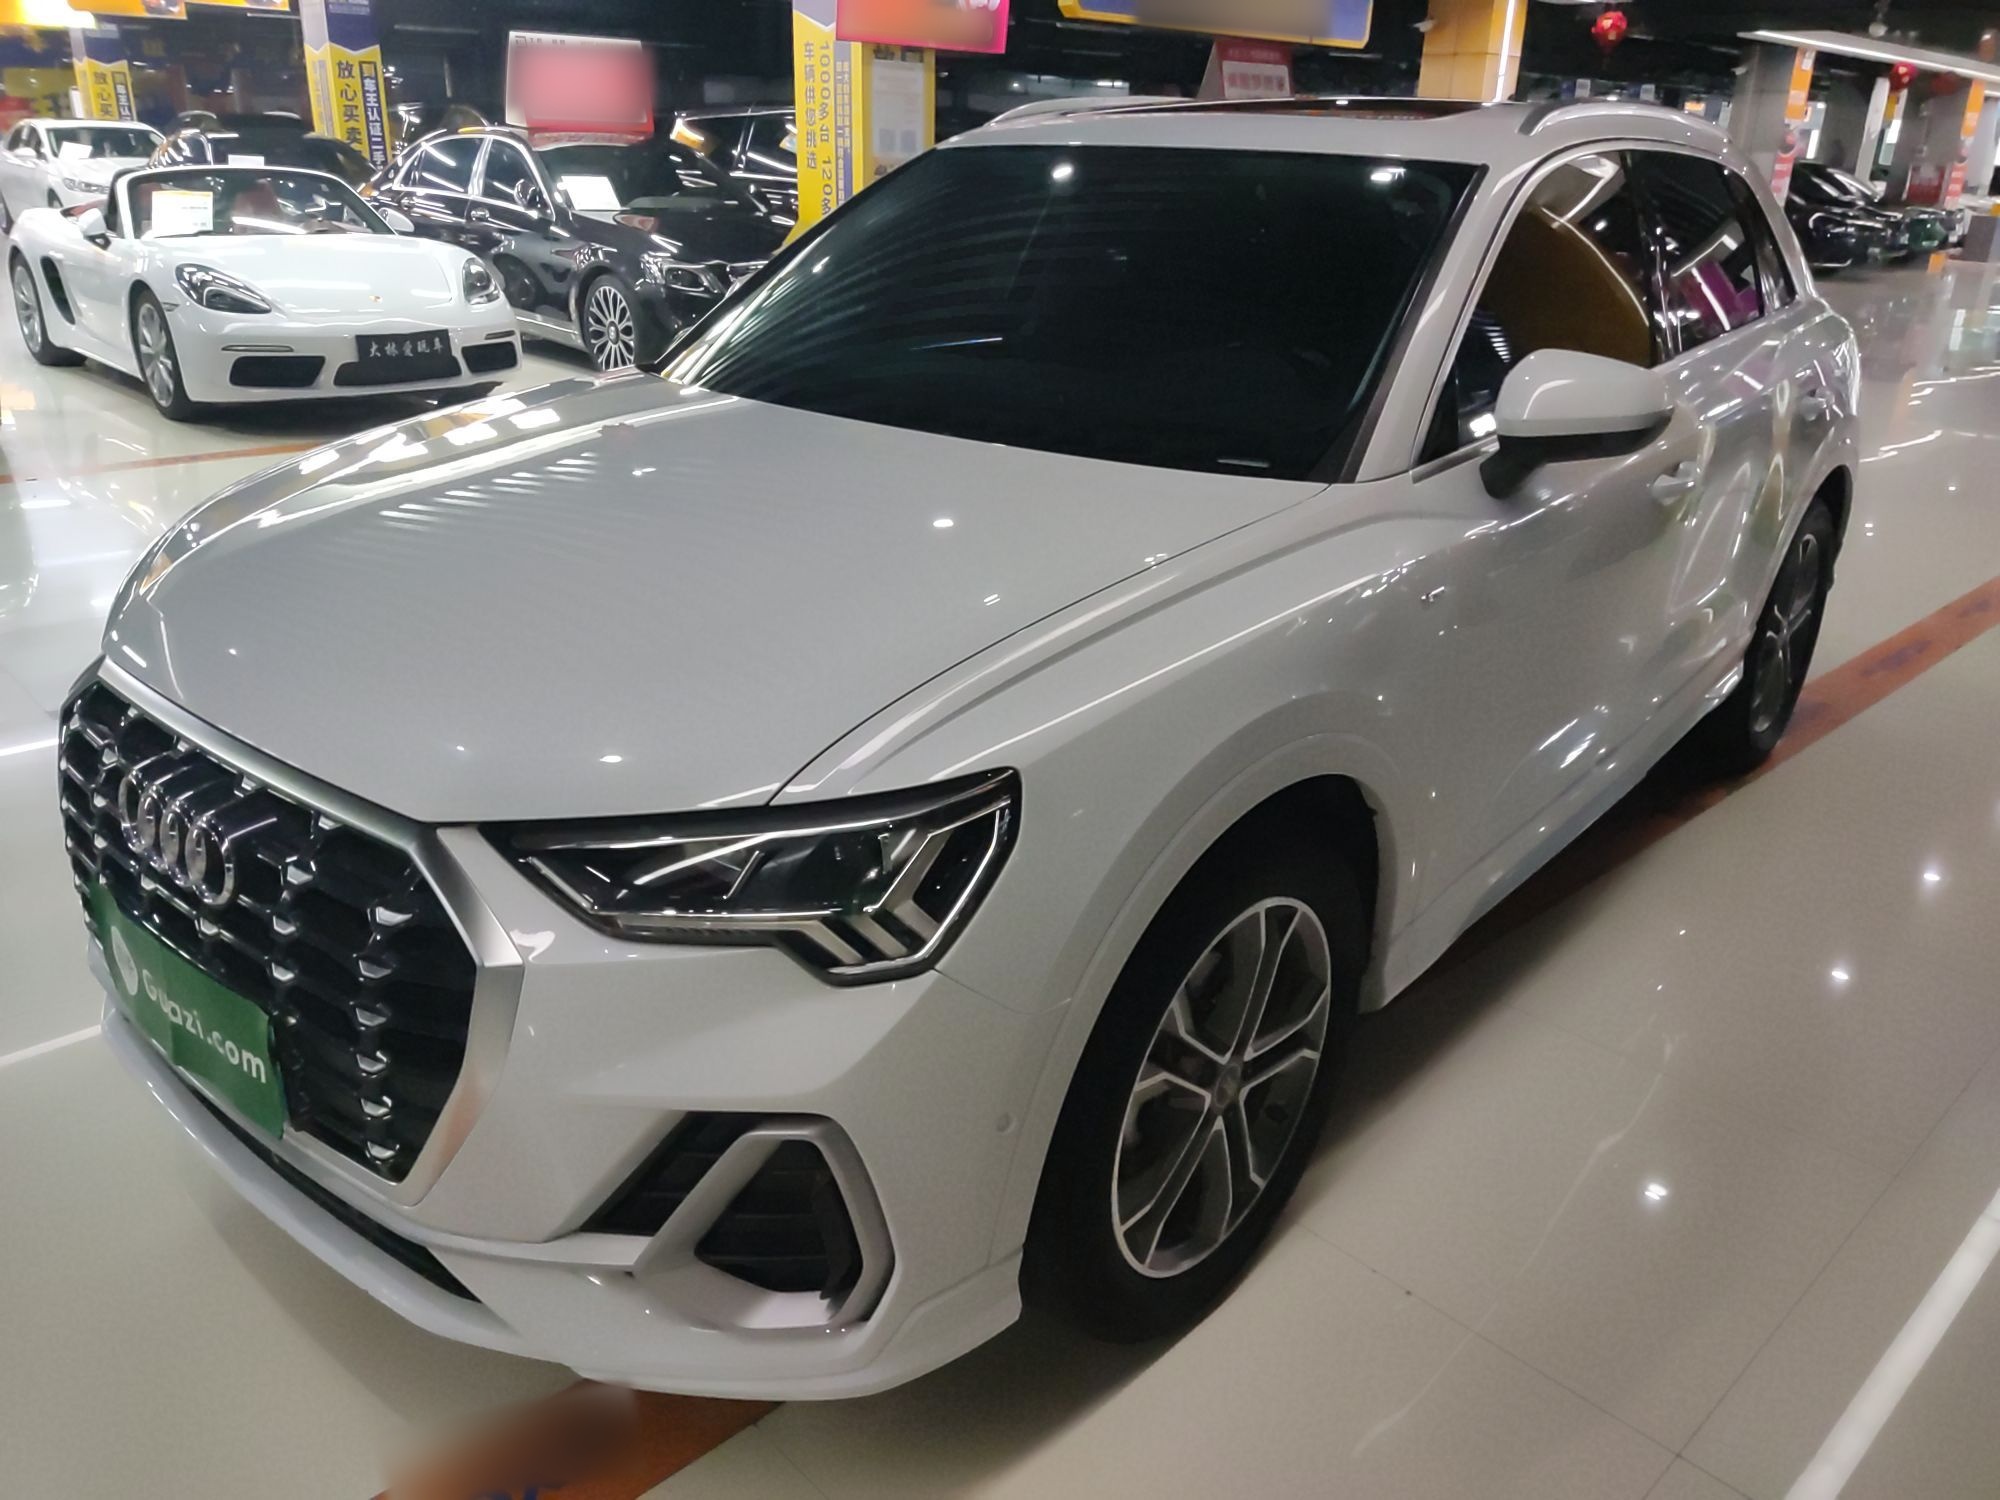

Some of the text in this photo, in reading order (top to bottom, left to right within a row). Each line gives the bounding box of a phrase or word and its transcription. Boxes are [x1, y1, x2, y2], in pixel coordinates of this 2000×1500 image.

[336, 60, 363, 145] 放心买卖
[360, 63, 385, 170] 车王认证二手
[142, 968, 267, 1084] Guazi.com
